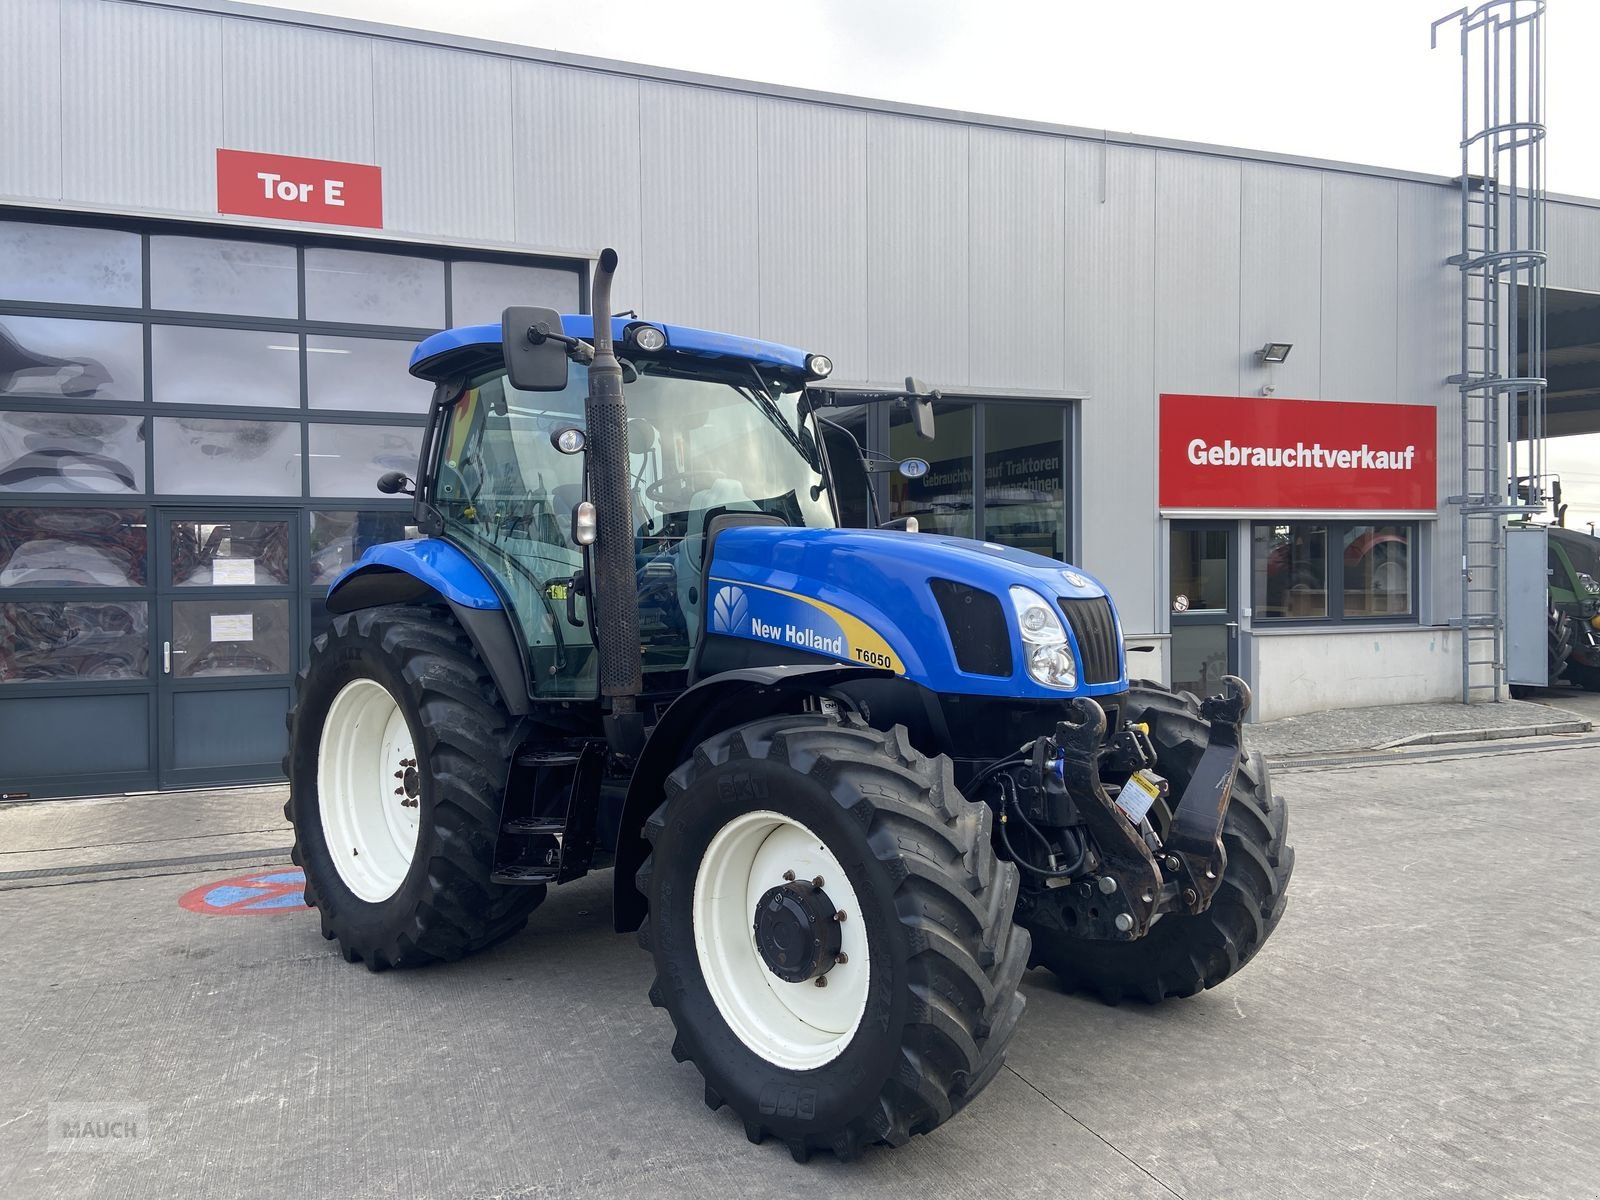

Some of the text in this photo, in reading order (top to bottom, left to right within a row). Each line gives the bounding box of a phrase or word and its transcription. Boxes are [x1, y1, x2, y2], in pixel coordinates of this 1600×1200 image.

[257, 172, 345, 206] Tor E
[1005, 456, 1059, 476] Traktoren
[1187, 438, 1415, 470] Gebrauchtverkauf
[751, 617, 842, 655] New Holland
[856, 648, 891, 668] T6050
